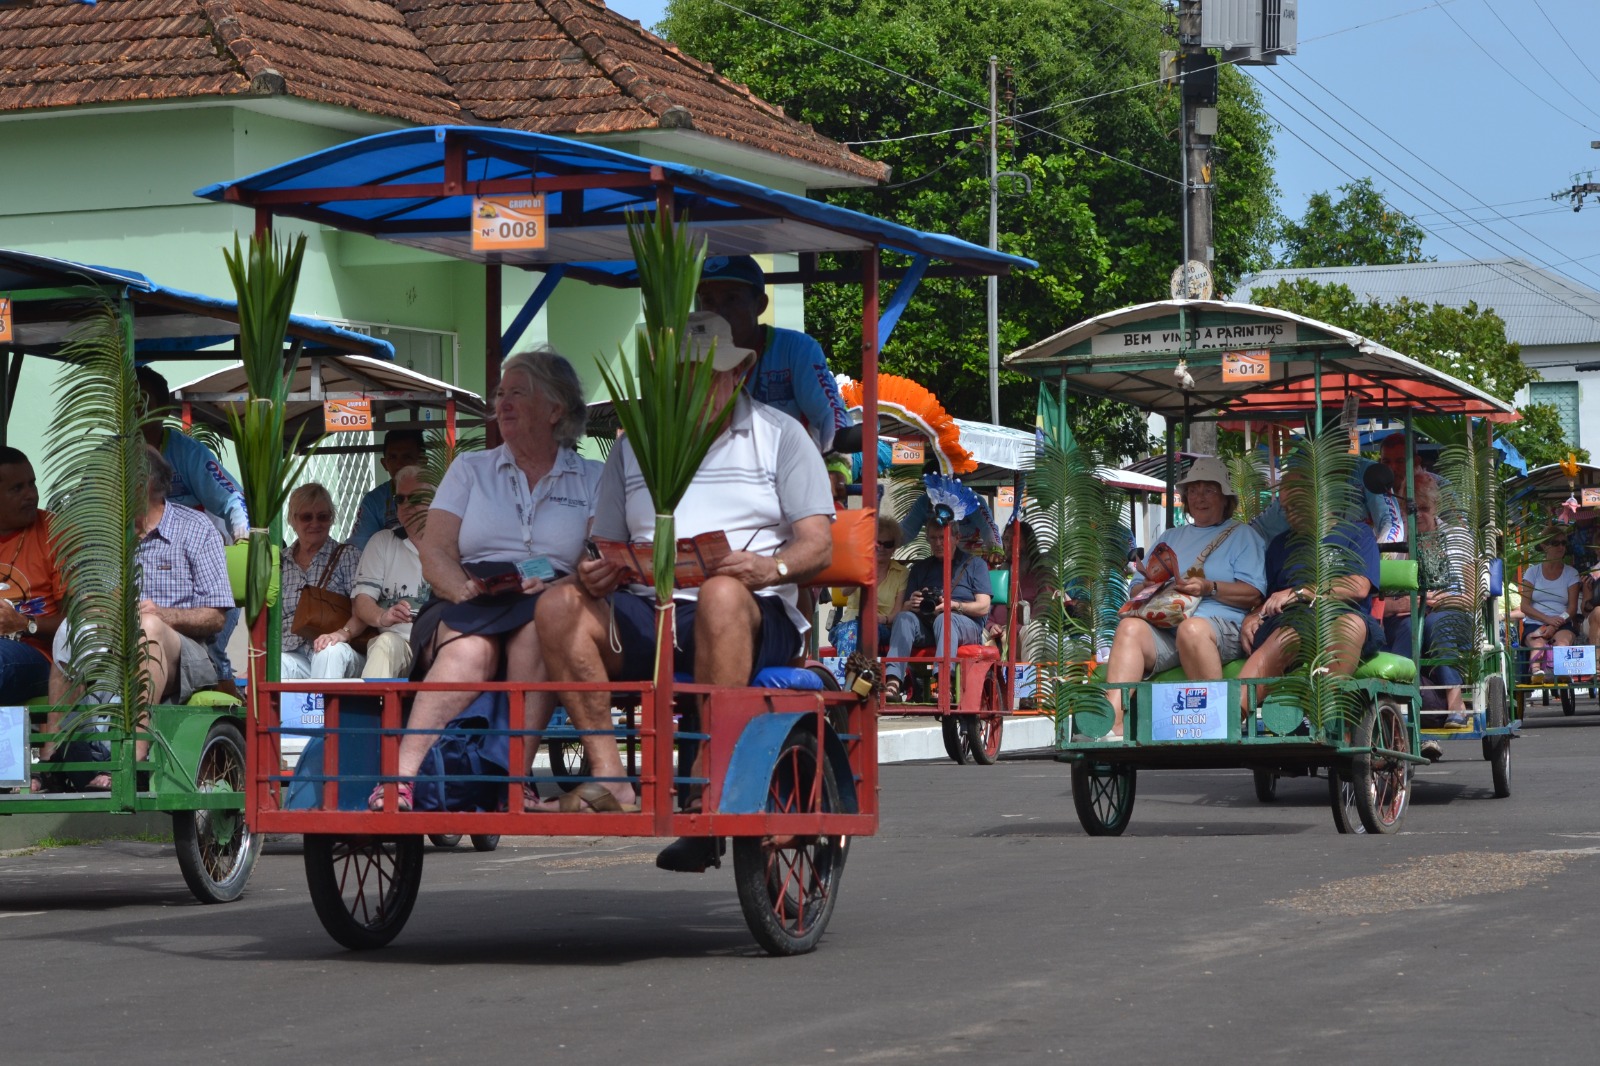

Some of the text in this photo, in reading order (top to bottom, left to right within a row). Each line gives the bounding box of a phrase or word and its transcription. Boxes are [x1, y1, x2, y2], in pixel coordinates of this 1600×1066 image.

[509, 200, 532, 209] GRUPO
[499, 221, 537, 239] 008
[1124, 333, 1152, 346] BEM
[1217, 324, 1284, 339] PARINTINS
[1240, 363, 1265, 375] 012
[341, 414, 367, 426] 005
[903, 451, 920, 460] 009
[302, 713, 325, 725] LUCI
[1172, 714, 1206, 725] NILSON
[1190, 728, 1202, 738] 10
